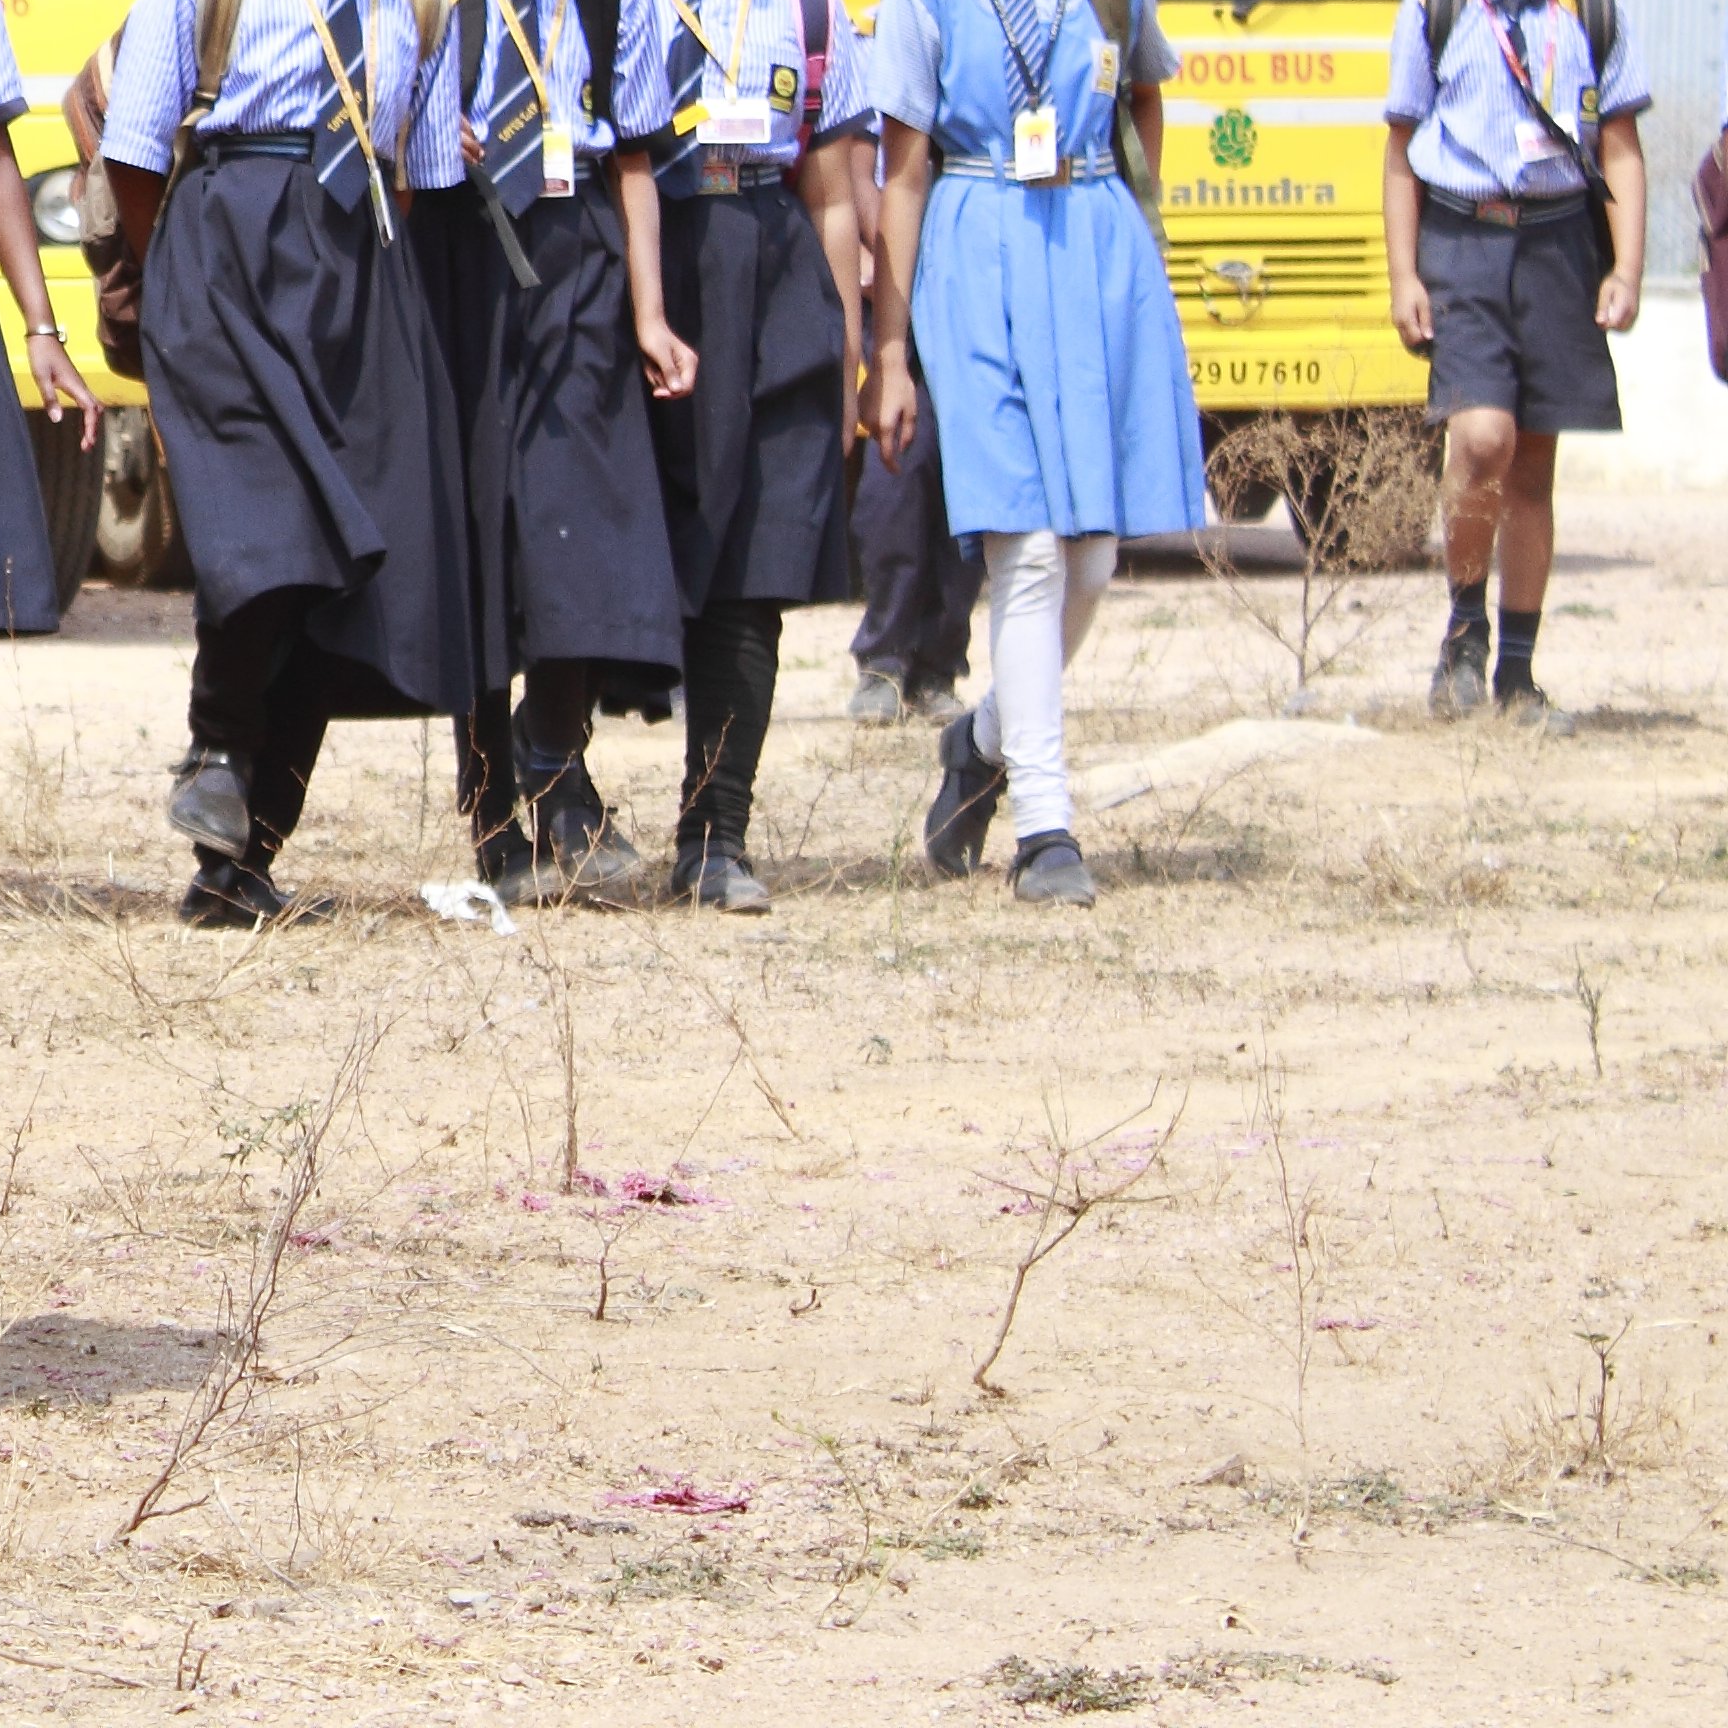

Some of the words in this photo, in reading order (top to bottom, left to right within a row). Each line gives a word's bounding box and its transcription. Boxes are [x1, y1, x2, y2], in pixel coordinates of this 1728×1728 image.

[1271, 54, 1335, 83] BUS
[1161, 178, 1336, 206] ahindra
[1255, 360, 1321, 385] 7610
